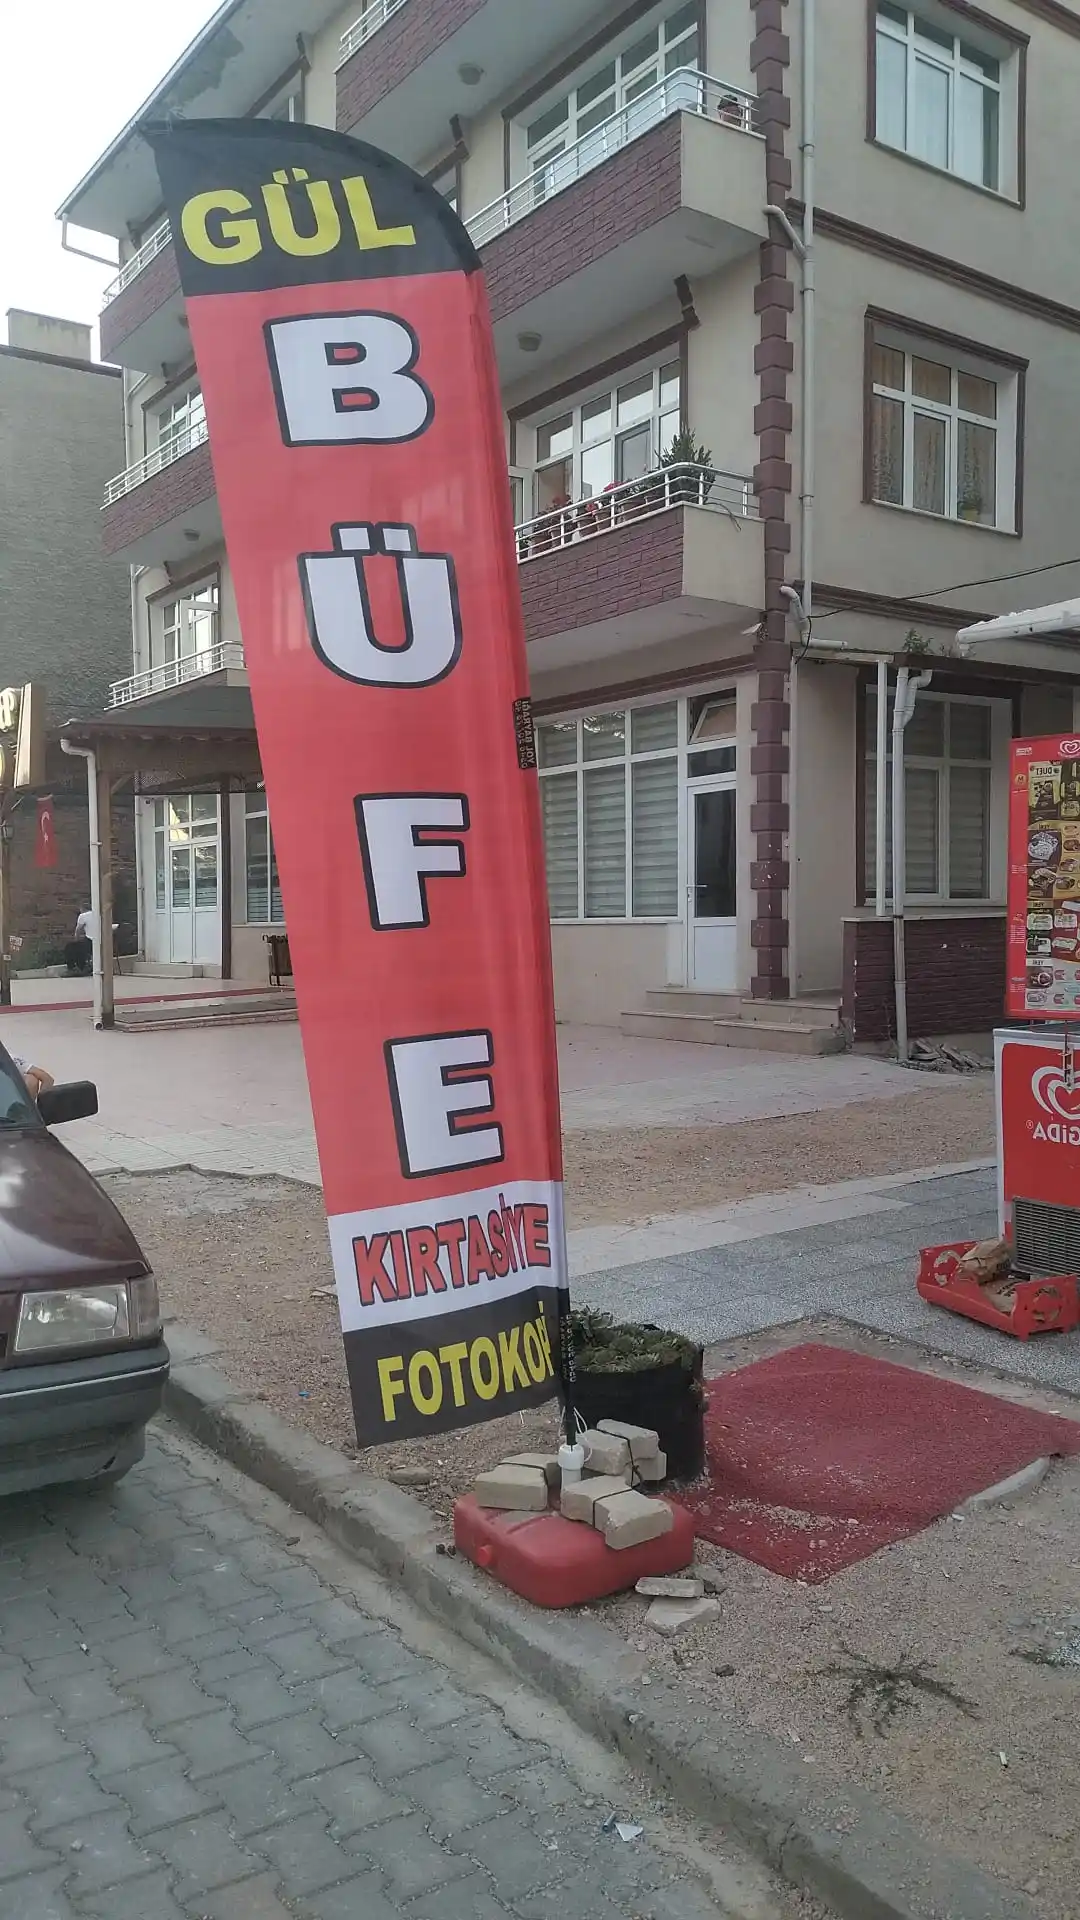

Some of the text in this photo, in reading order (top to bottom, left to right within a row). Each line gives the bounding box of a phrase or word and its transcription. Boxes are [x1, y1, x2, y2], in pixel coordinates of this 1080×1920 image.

[181, 168, 416, 264] GÜL
[262, 309, 505, 1178] BÜFE
[352, 1193, 551, 1307] KIRTASİYE
